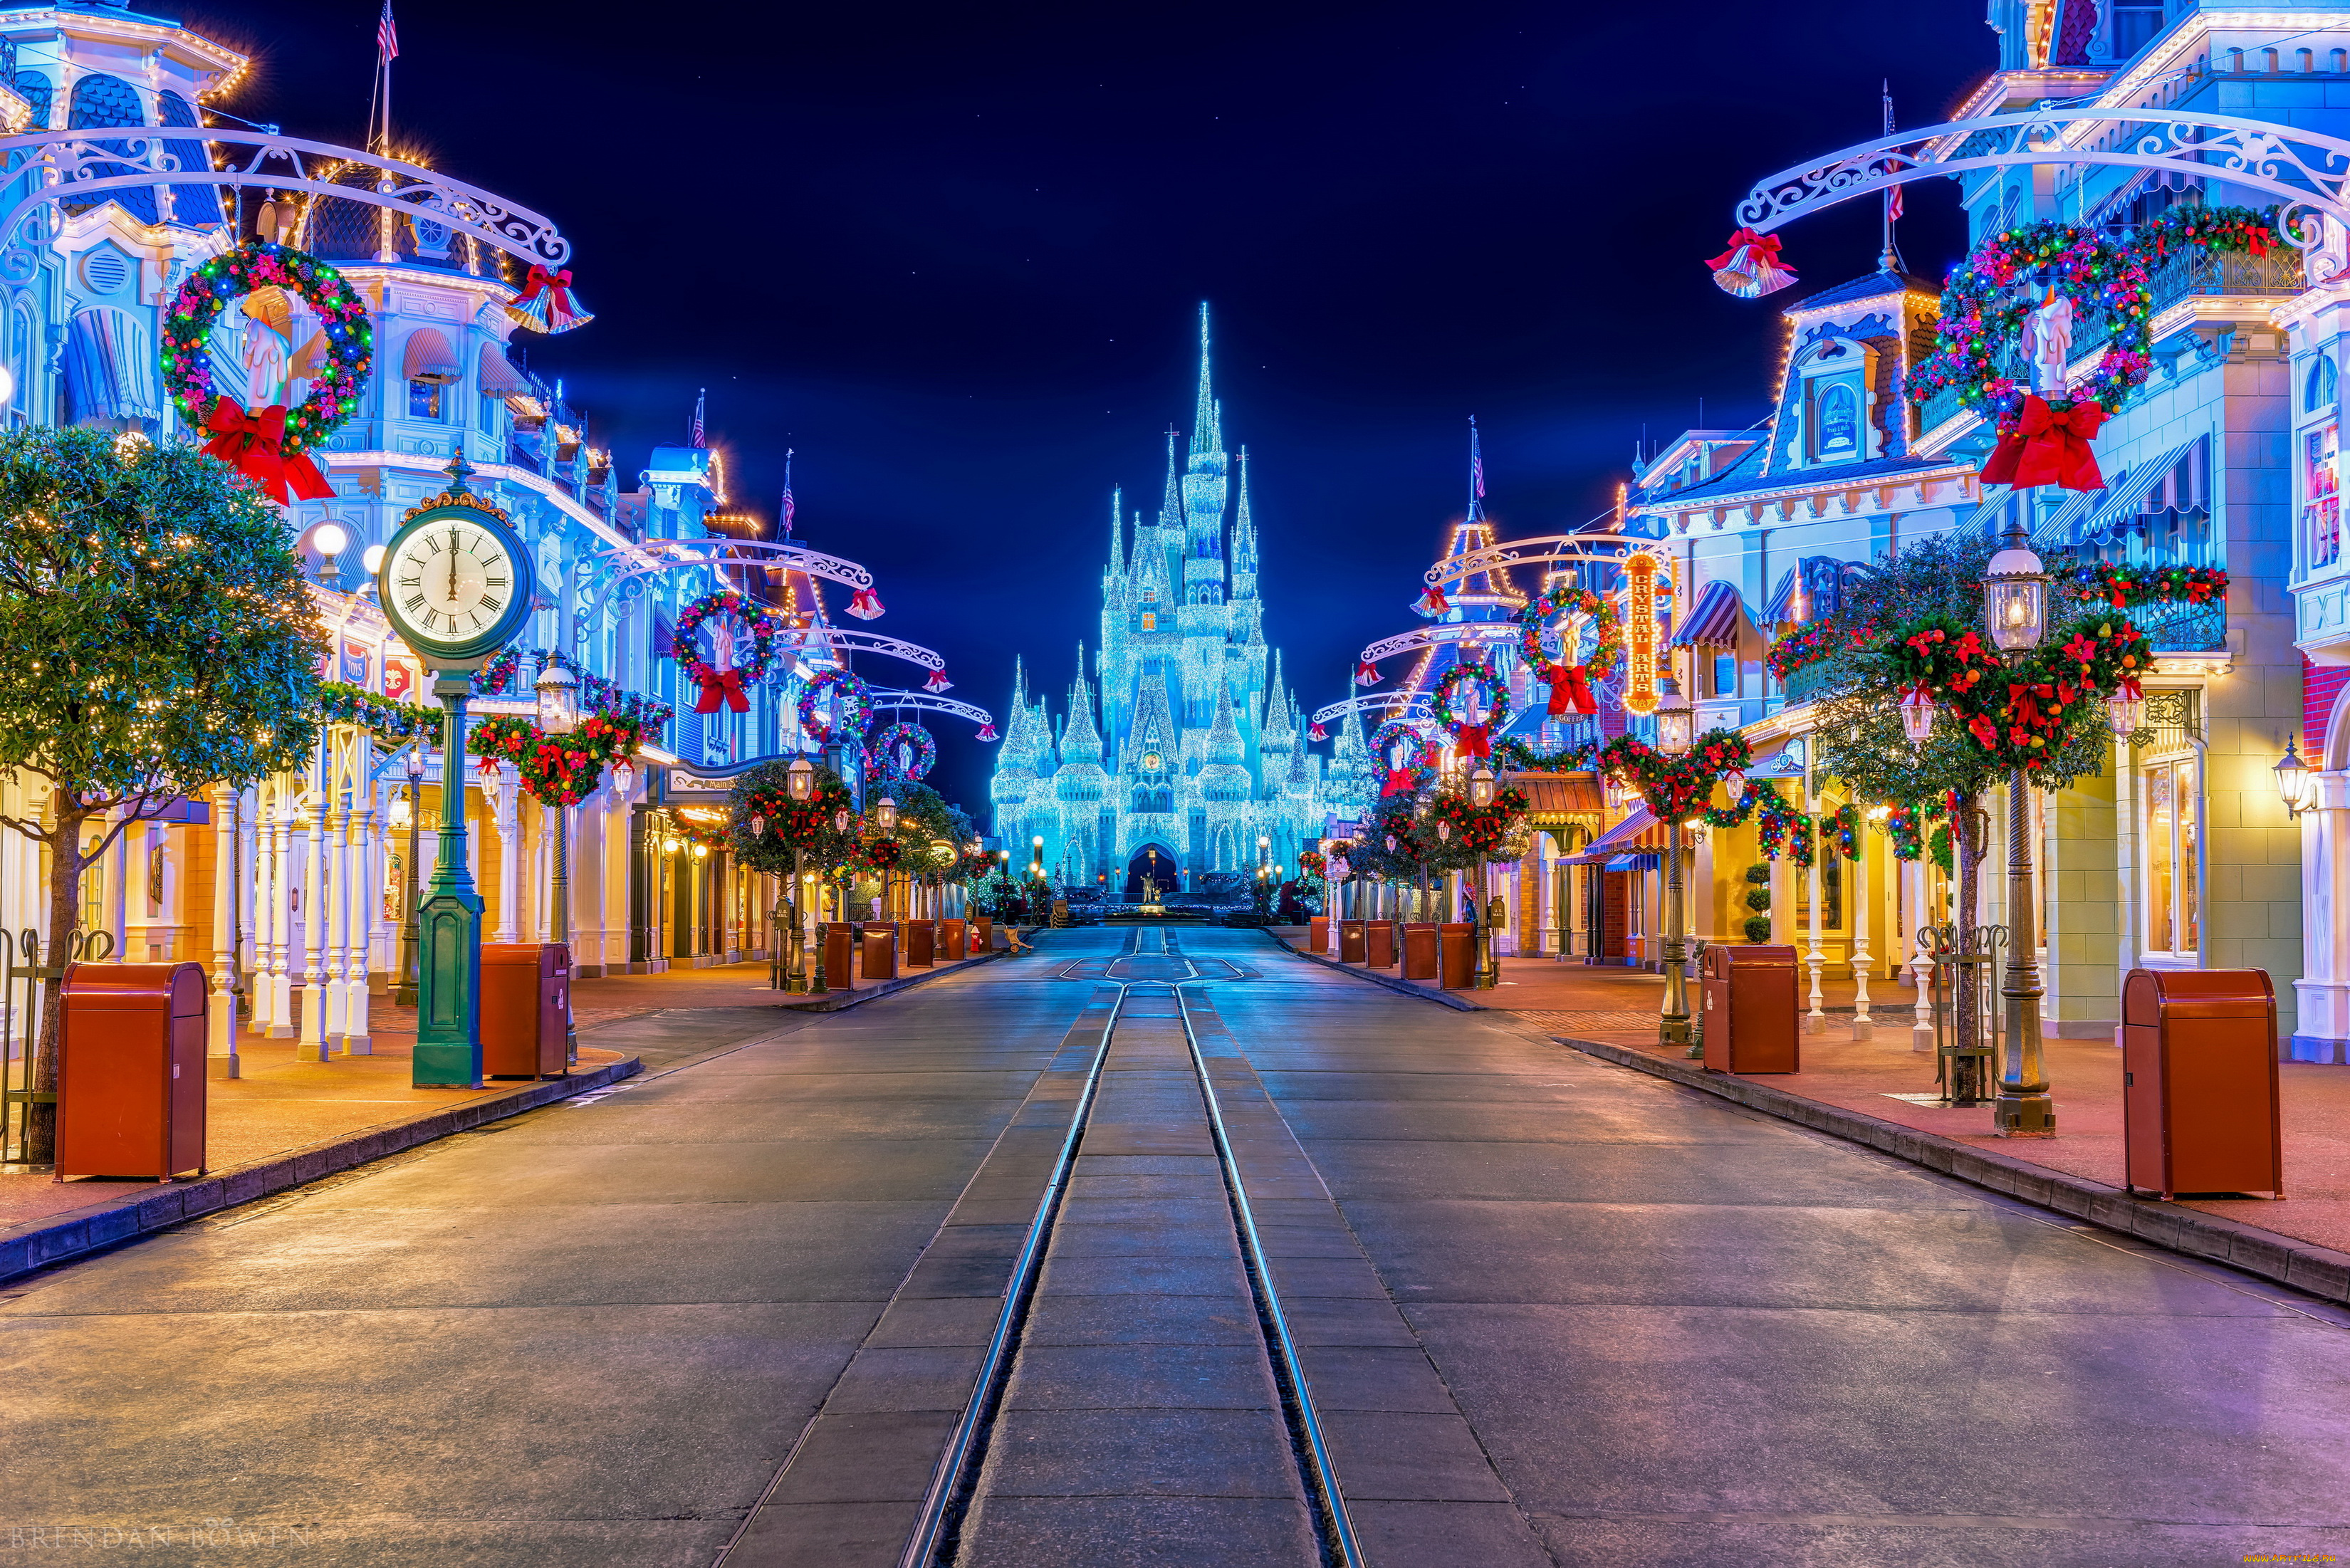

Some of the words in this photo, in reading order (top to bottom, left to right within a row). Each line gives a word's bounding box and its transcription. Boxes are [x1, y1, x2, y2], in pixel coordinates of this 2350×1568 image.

[424, 535, 441, 555] XI
[407, 553, 427, 568] X
[402, 577, 420, 586] IX
[486, 577, 506, 586] III
[405, 593, 427, 613] VIII
[1634, 575, 1649, 643] CRYSTAL
[422, 607, 439, 629] VII
[447, 615, 459, 633] VI
[469, 610, 482, 627] V
[347, 659, 362, 676] TOYS
[1634, 654, 1650, 692] ARTS
[709, 780, 727, 790] Main
